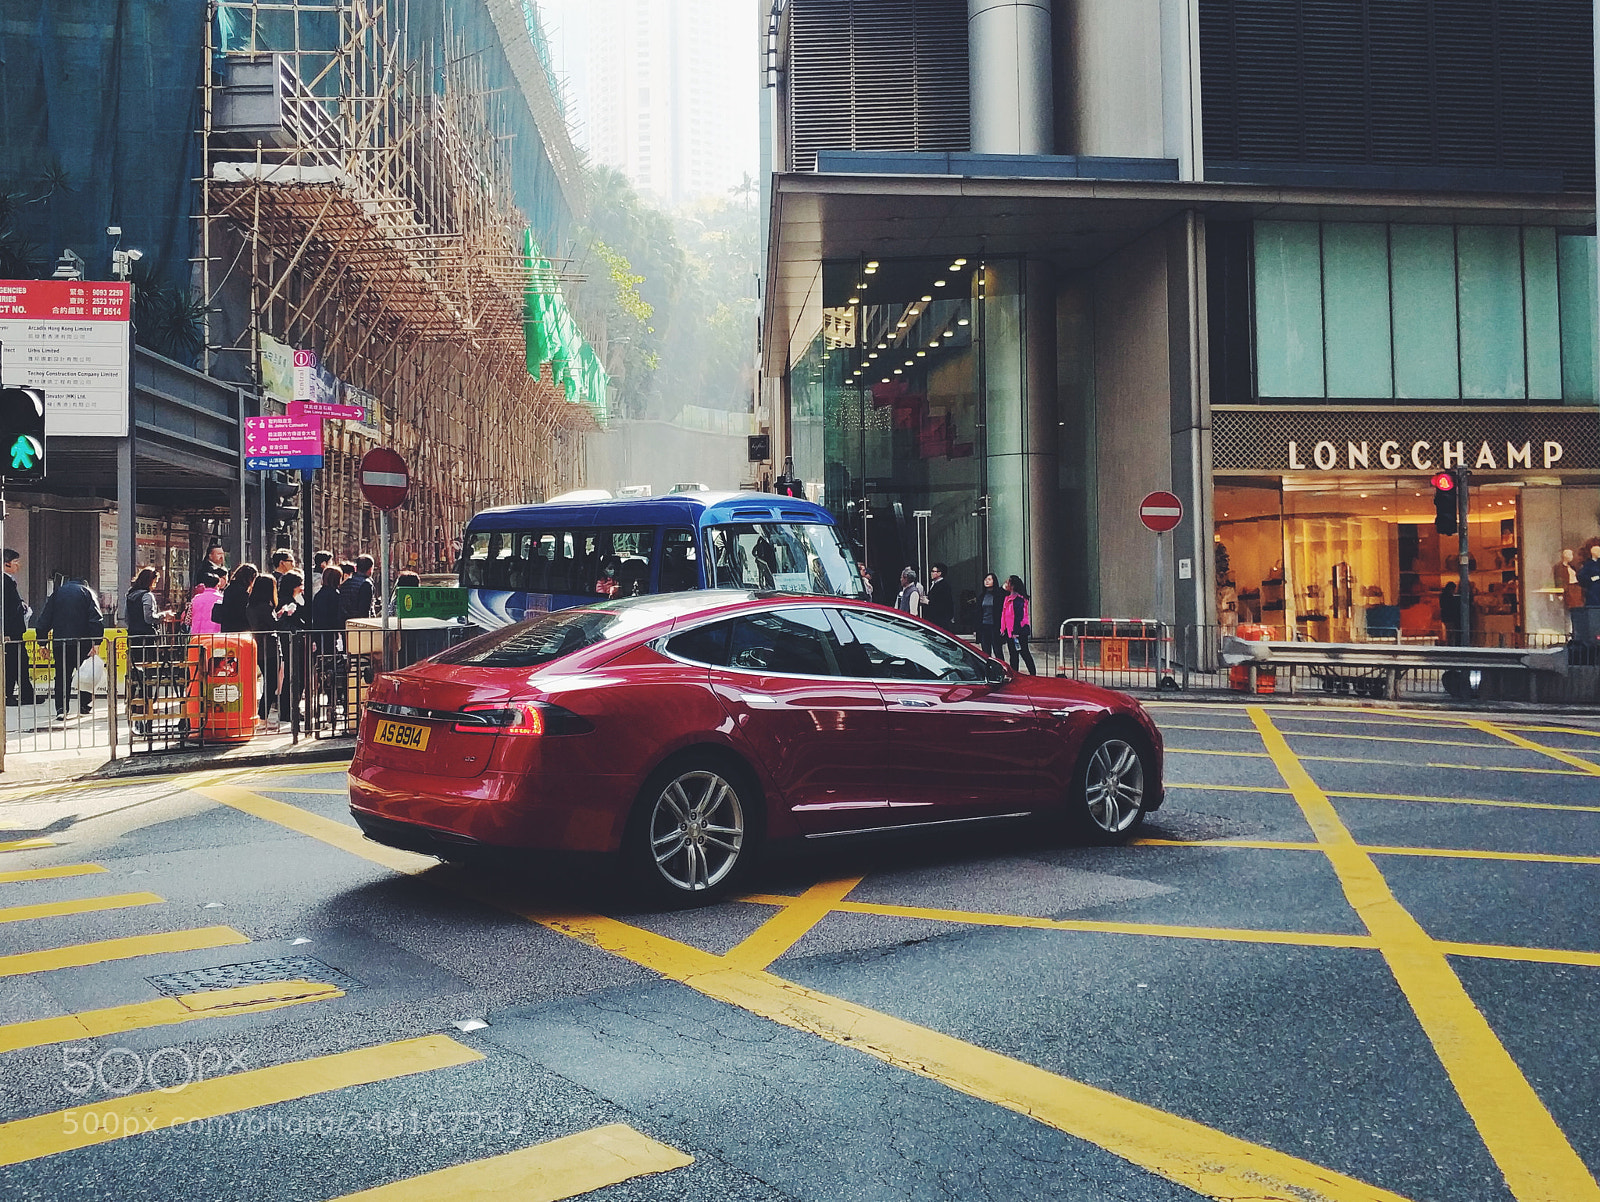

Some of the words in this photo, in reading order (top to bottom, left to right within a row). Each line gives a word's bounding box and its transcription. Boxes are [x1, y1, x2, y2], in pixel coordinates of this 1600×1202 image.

[108, 298, 124, 306] 7017
[11, 305, 27, 314] NO.
[92, 307, 102, 315] RF
[103, 307, 122, 316] D514
[1289, 440, 1564, 470] LONGCHAMP
[380, 723, 395, 742] AS
[395, 725, 423, 747] 8914
